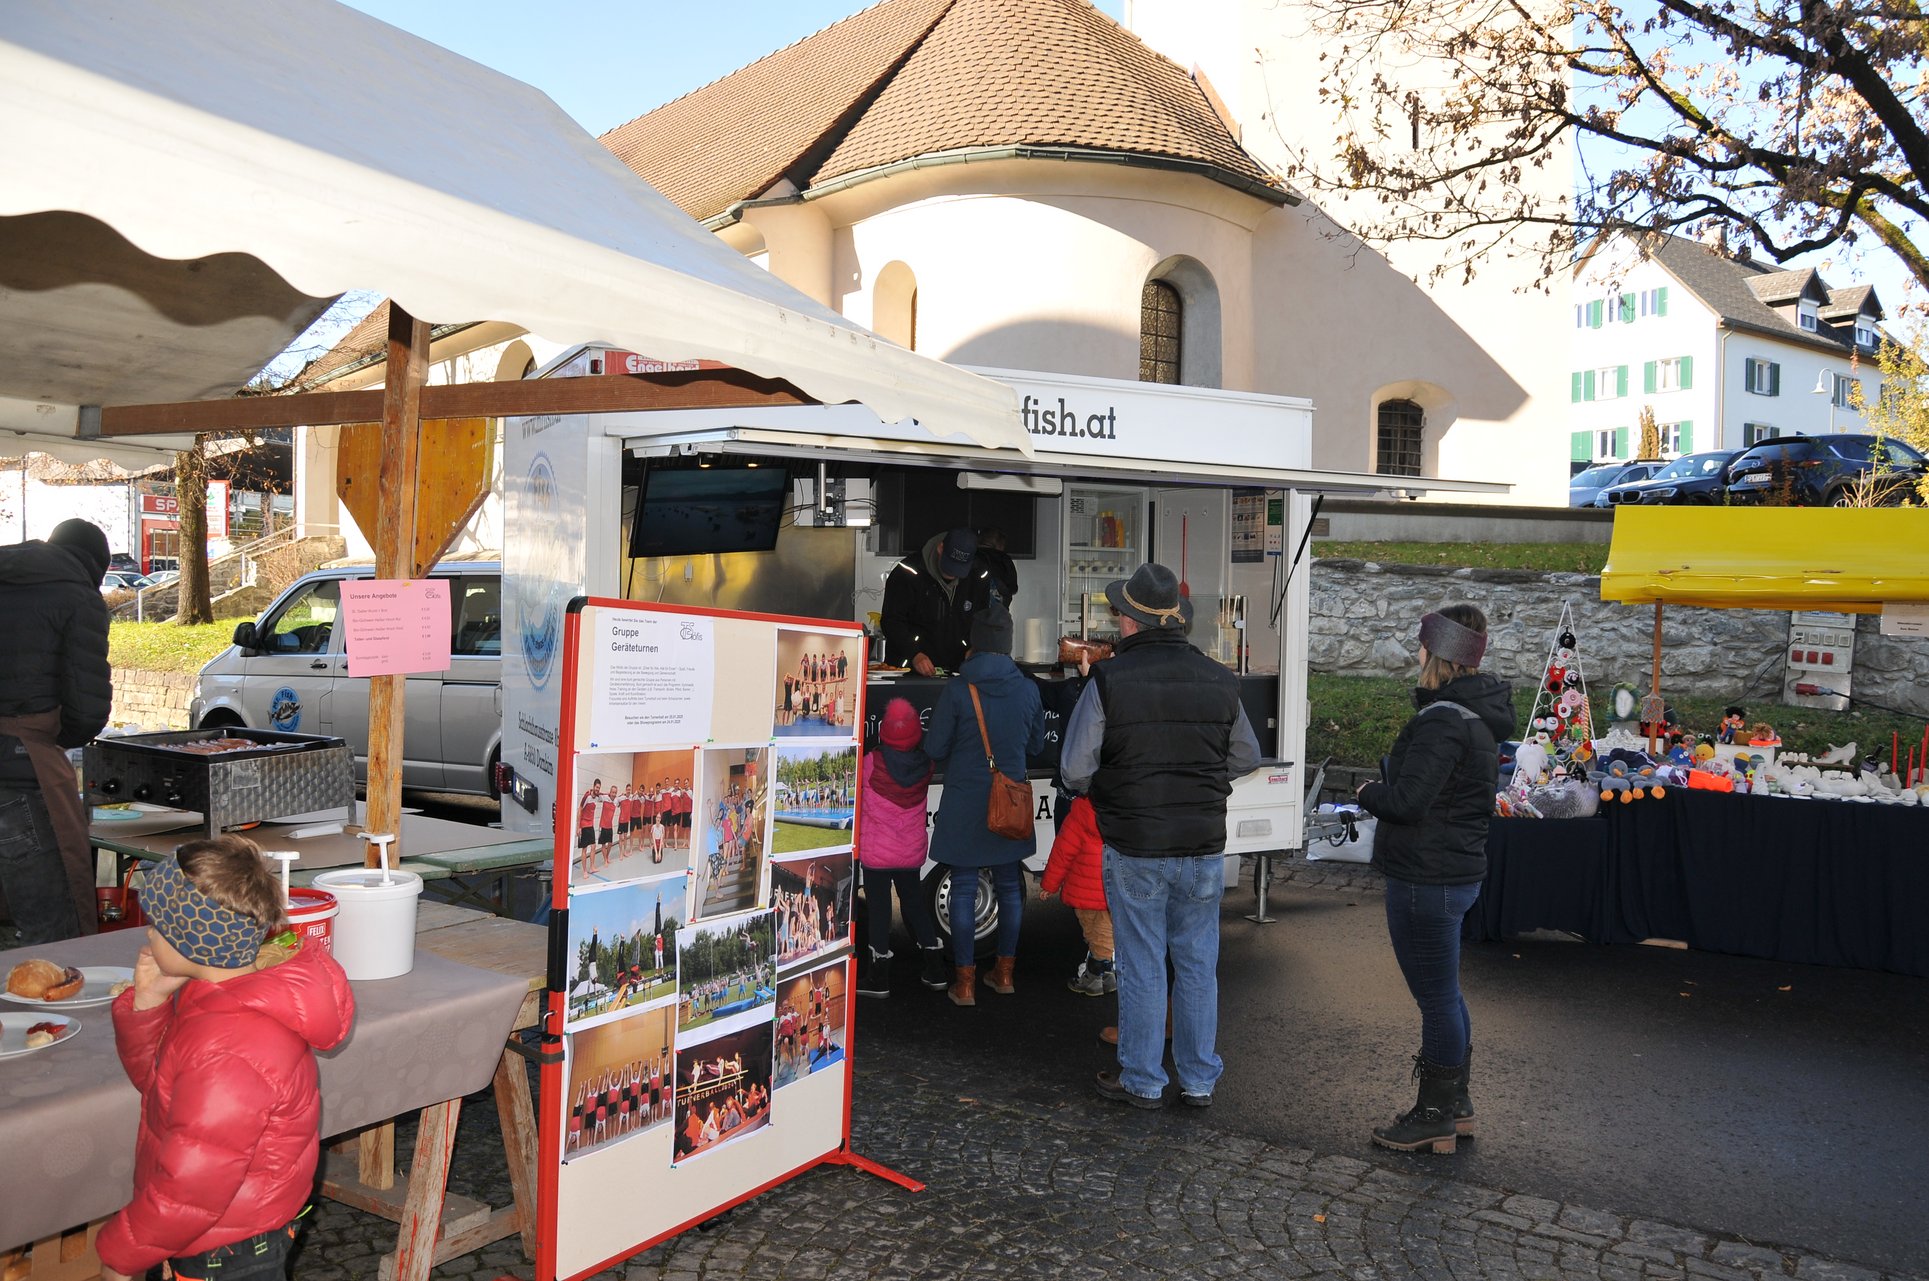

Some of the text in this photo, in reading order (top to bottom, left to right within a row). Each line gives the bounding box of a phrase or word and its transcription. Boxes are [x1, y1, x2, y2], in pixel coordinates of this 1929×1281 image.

[155, 498, 180, 511] SP
[371, 592, 398, 601] Angebote
[611, 626, 640, 639] Gruppe
[611, 641, 660, 653] Geräteturnen
